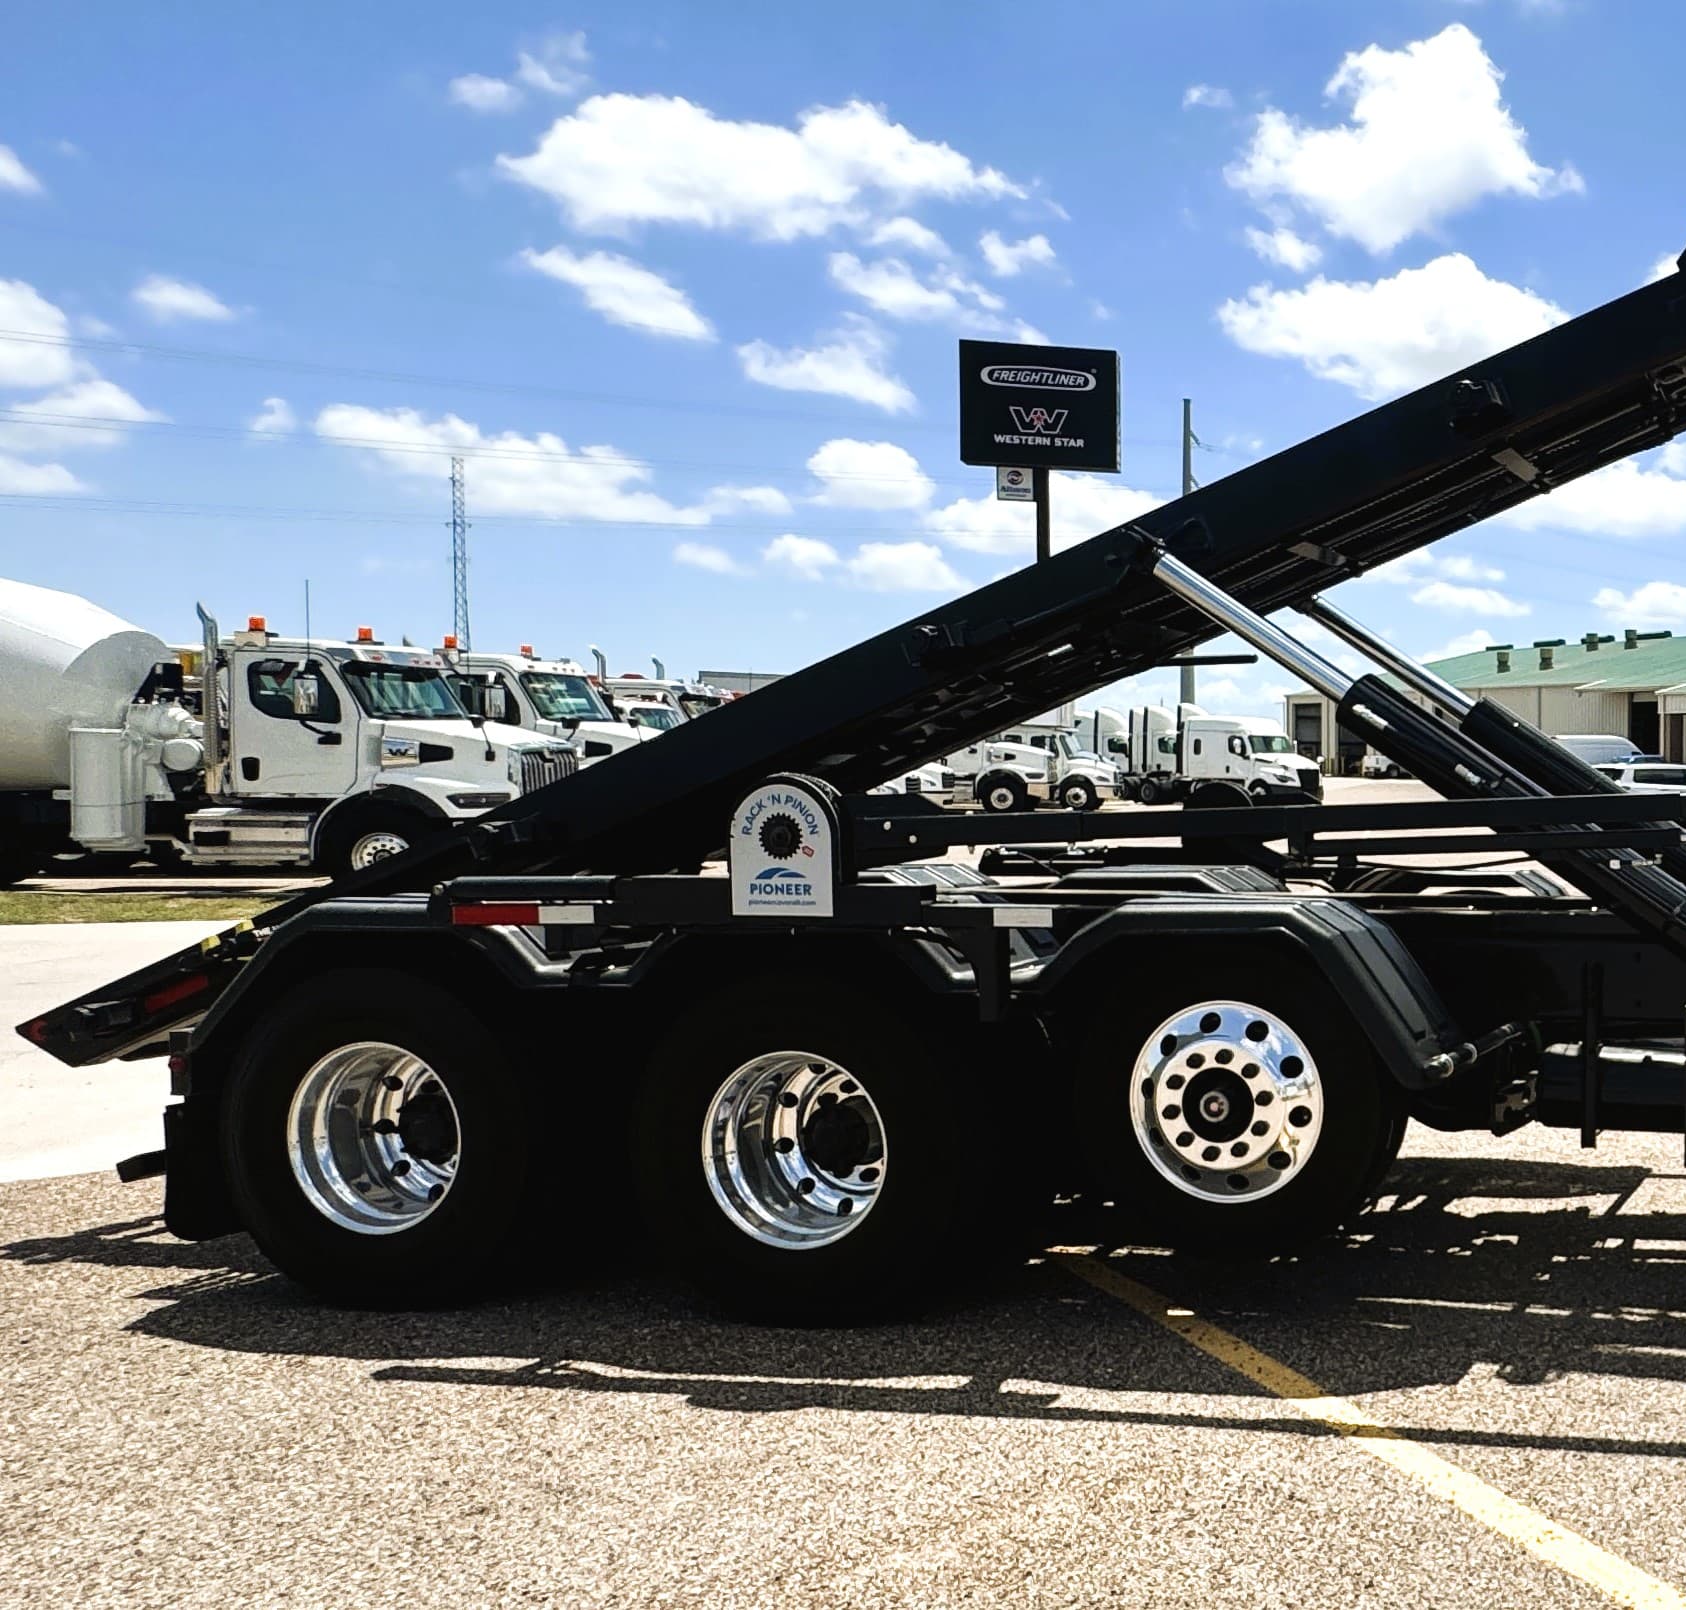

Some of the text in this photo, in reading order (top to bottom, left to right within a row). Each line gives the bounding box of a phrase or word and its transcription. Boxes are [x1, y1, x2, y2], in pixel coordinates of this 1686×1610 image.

[992, 370, 1086, 386] FREIGHTLINER
[994, 433, 1084, 448] WESTERN STAR
[742, 799, 767, 835] RACK
[784, 795, 819, 835] PINION
[750, 883, 812, 896] PIONEER
